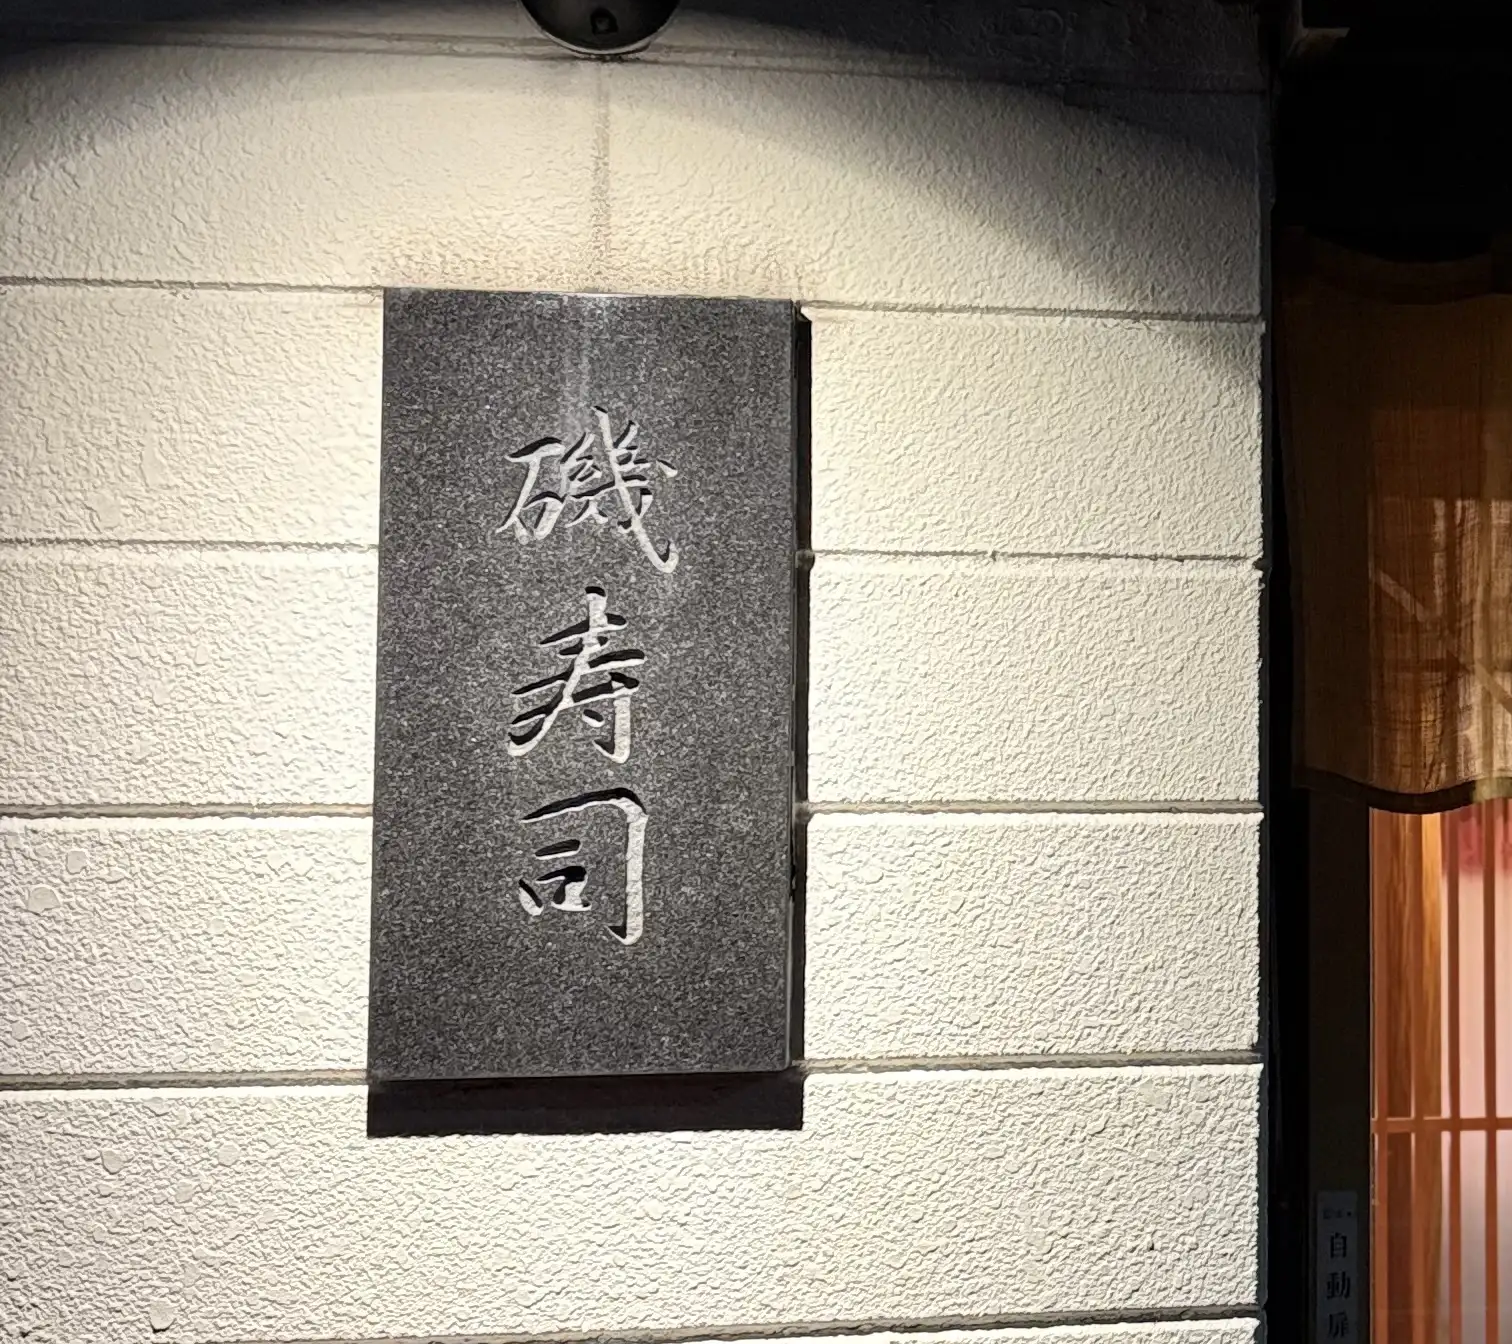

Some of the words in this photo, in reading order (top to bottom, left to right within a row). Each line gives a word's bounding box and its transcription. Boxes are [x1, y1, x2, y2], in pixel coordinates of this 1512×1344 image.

[496, 405, 678, 945] 磯寿司
[1327, 1232, 1351, 1338] 自動扉
